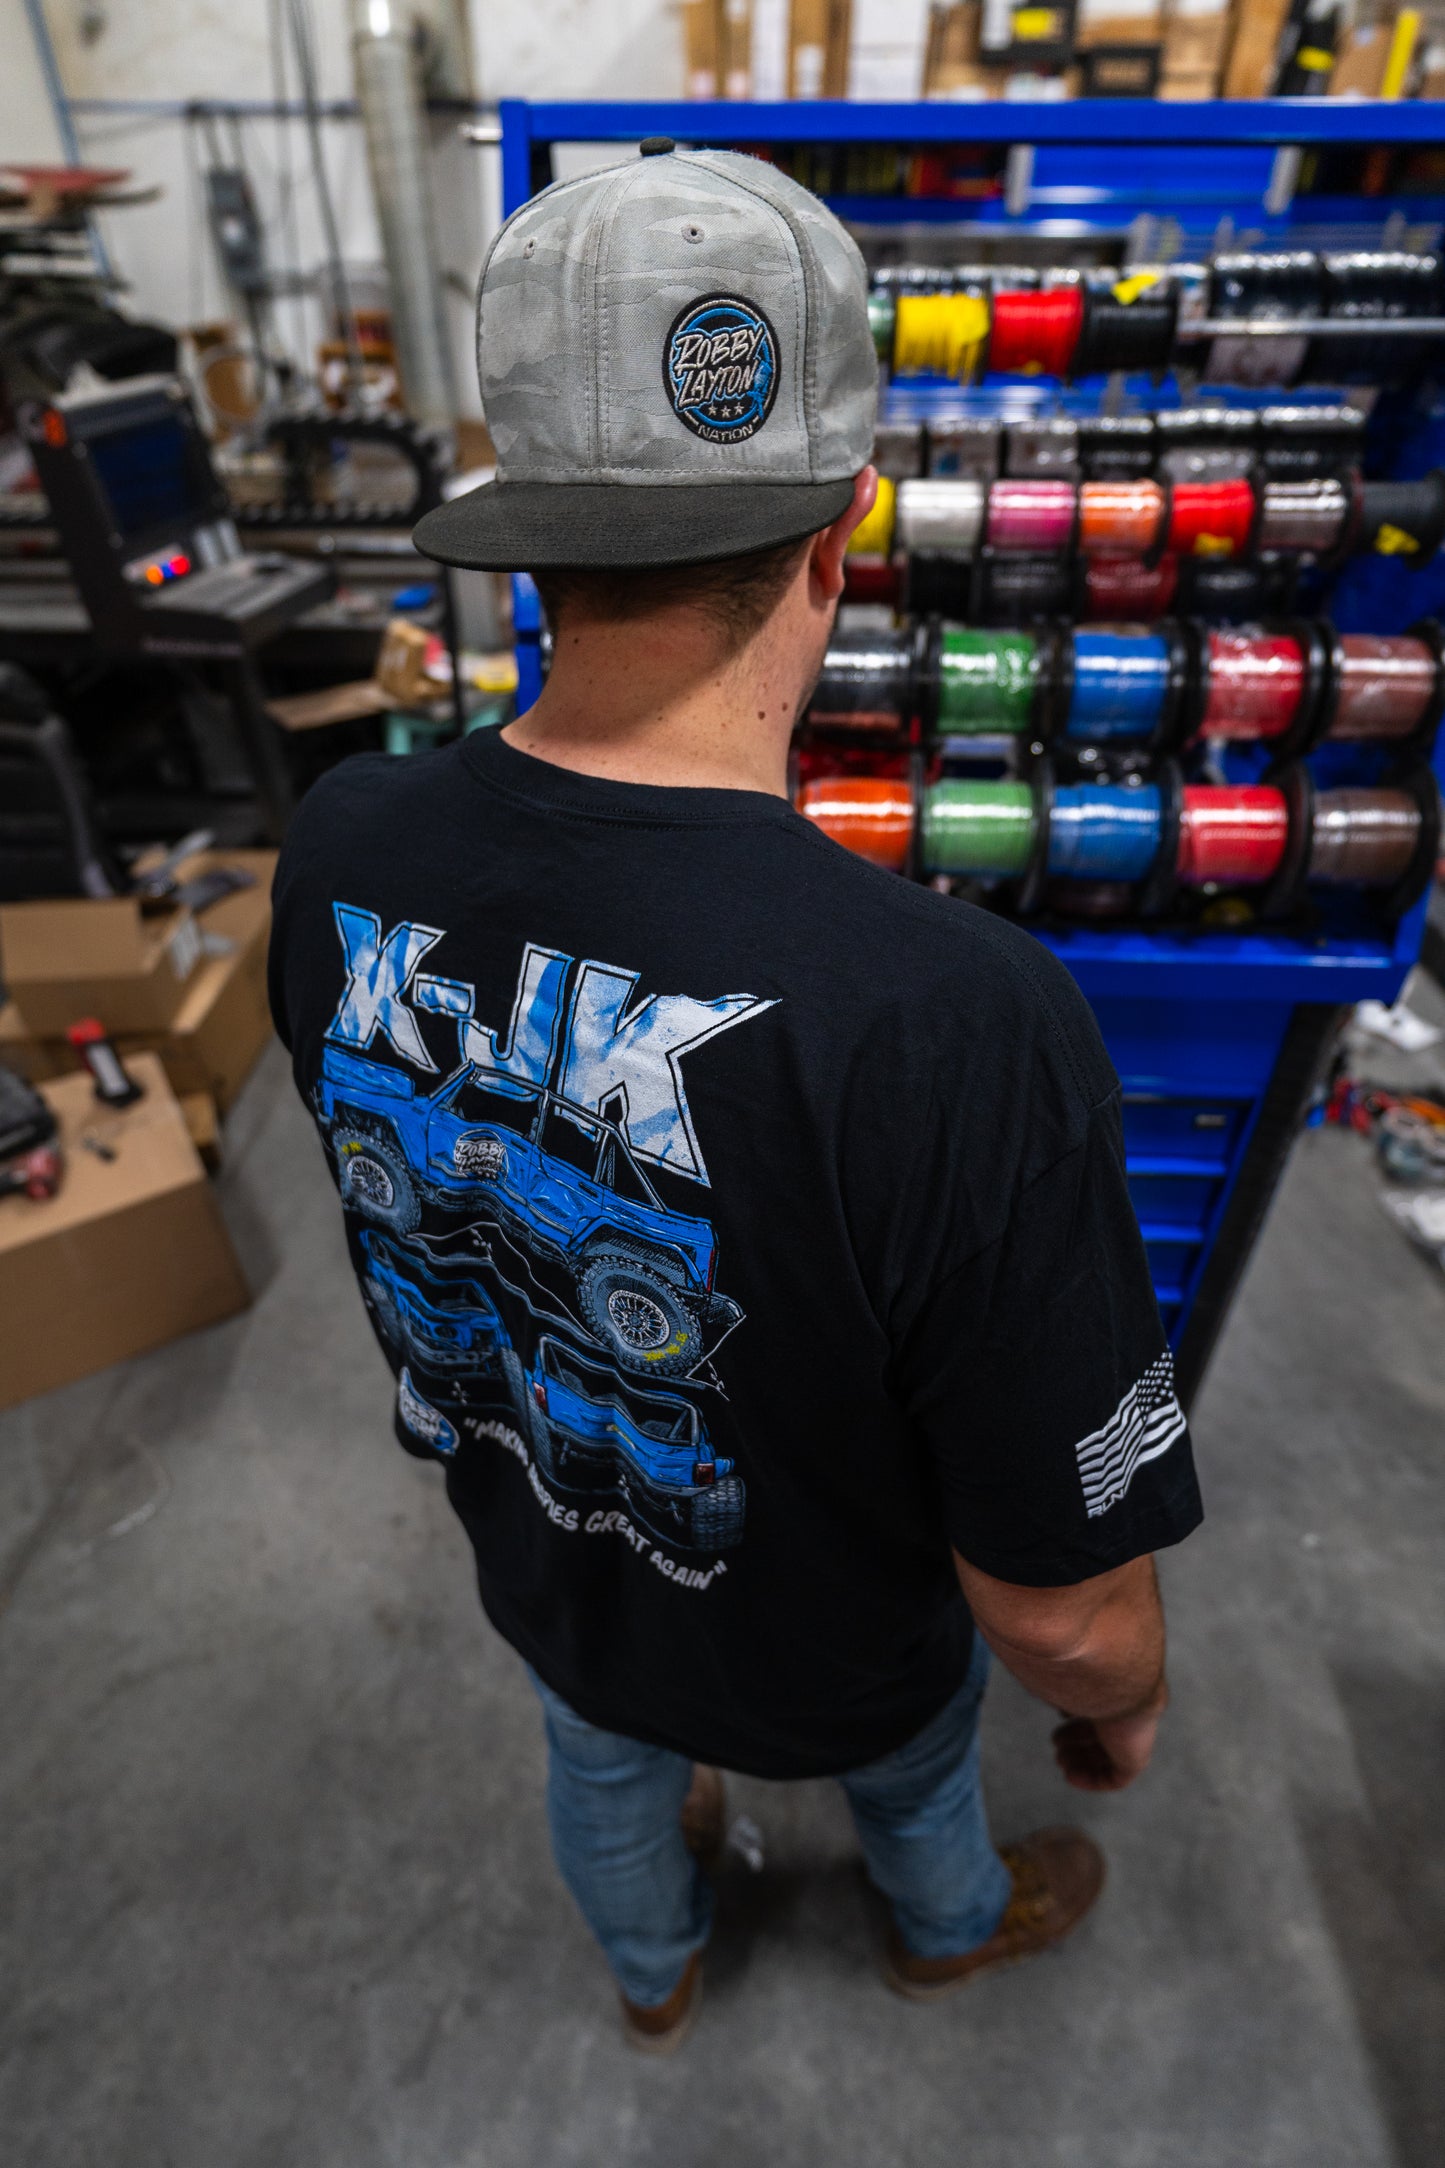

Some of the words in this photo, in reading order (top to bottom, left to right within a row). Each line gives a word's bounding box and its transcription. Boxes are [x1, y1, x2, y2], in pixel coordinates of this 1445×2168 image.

[675, 328, 763, 376] ROBBY
[679, 363, 759, 407] LAYTON
[698, 423, 753, 441] NATION
[585, 1510, 652, 1553] GREAT
